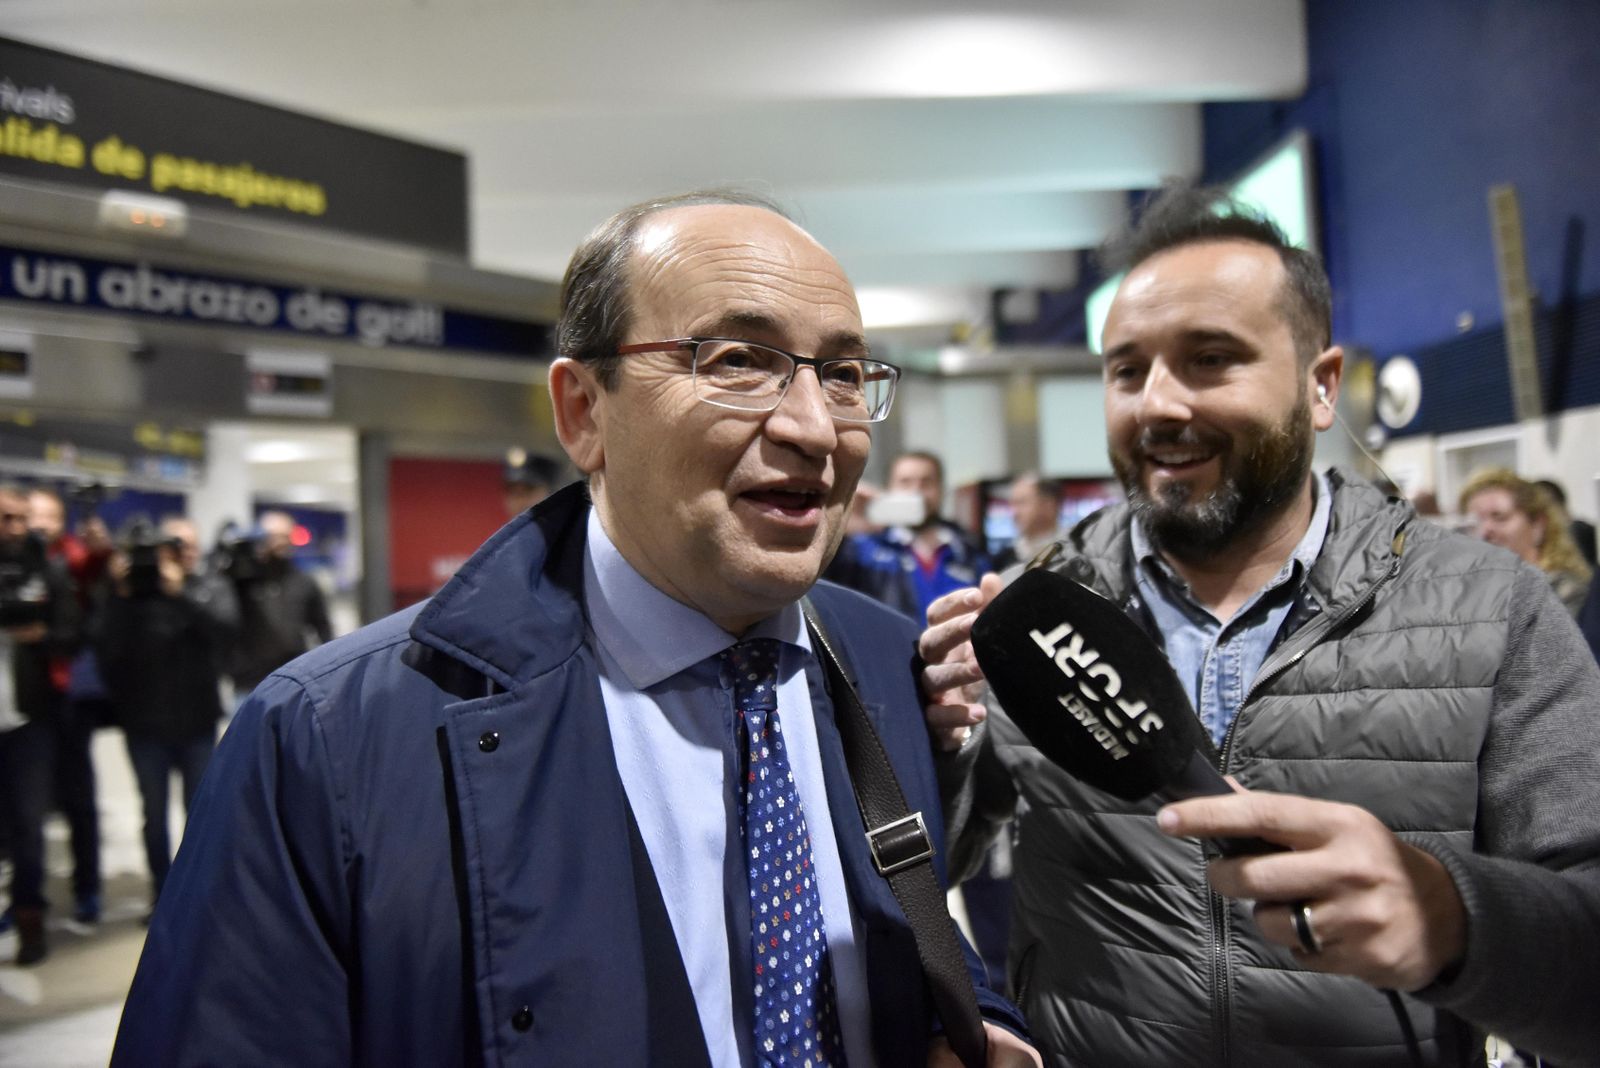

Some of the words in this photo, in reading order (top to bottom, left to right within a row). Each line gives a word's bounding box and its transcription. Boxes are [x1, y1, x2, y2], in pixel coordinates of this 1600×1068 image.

[0, 117, 85, 169] lida
[91, 135, 146, 181] de
[151, 153, 327, 216] pasajeros
[12, 255, 87, 302] un
[97, 262, 280, 326] abrazo
[285, 289, 349, 335] de
[1028, 621, 1165, 746] SPORT
[1057, 692, 1130, 761] MEDIASET
